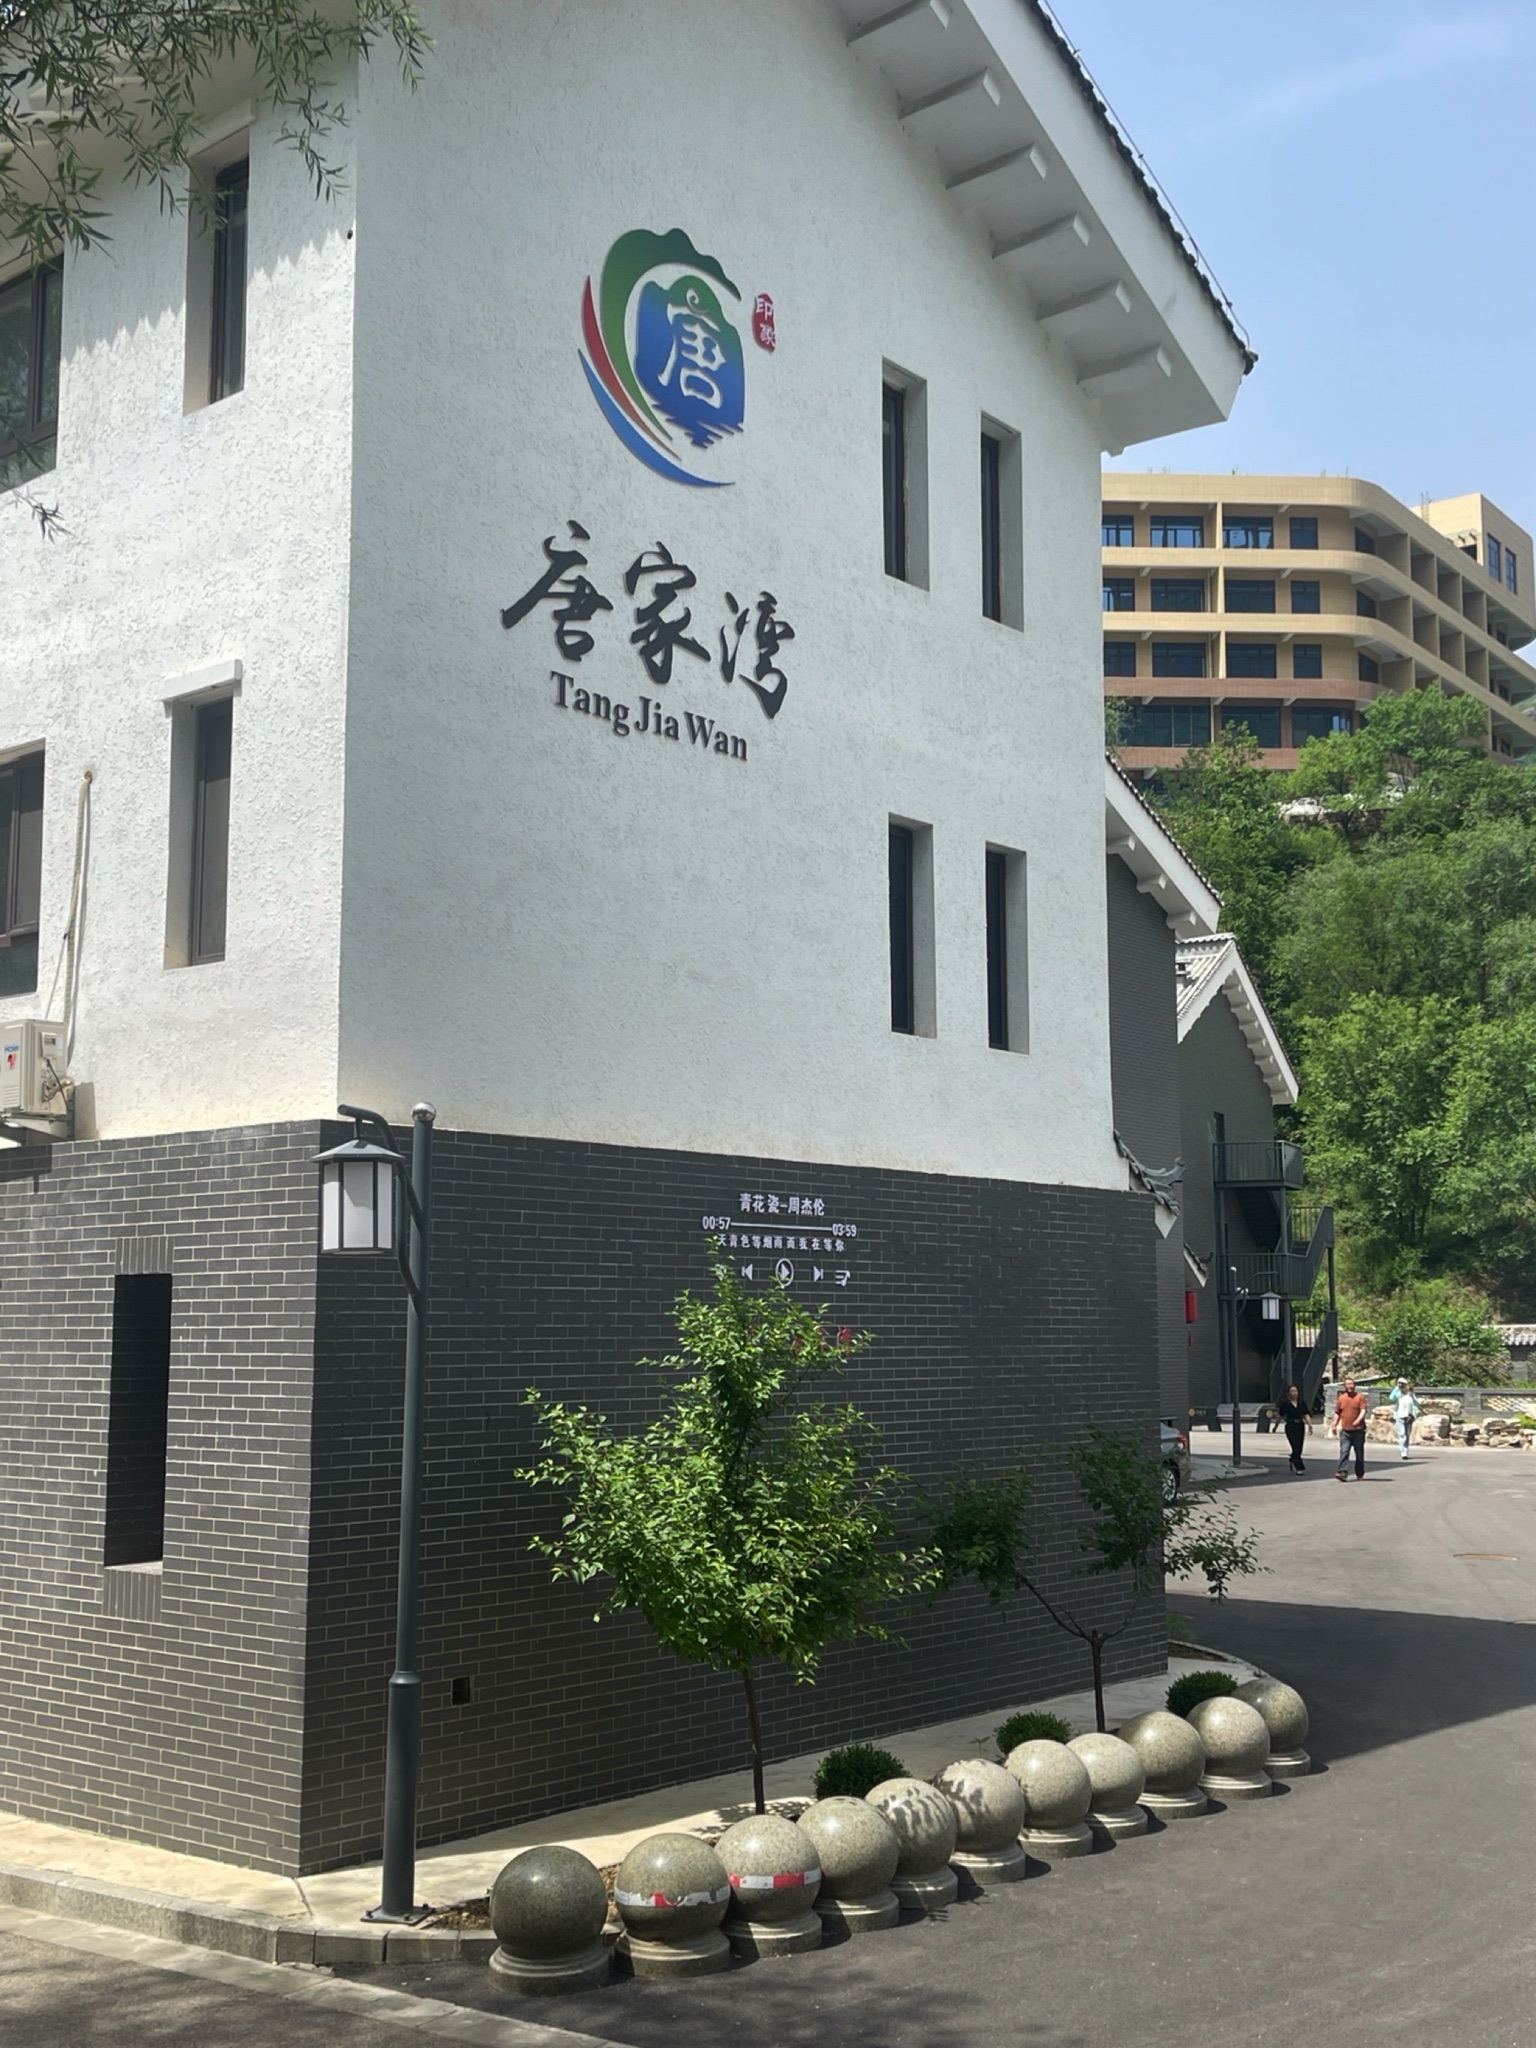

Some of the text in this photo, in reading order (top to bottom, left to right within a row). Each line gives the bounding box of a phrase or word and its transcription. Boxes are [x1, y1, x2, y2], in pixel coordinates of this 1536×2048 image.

[502, 520, 795, 719] 唐家湾
[702, 1216, 731, 1230] 00:57
[832, 1223, 857, 1237] 03:59
